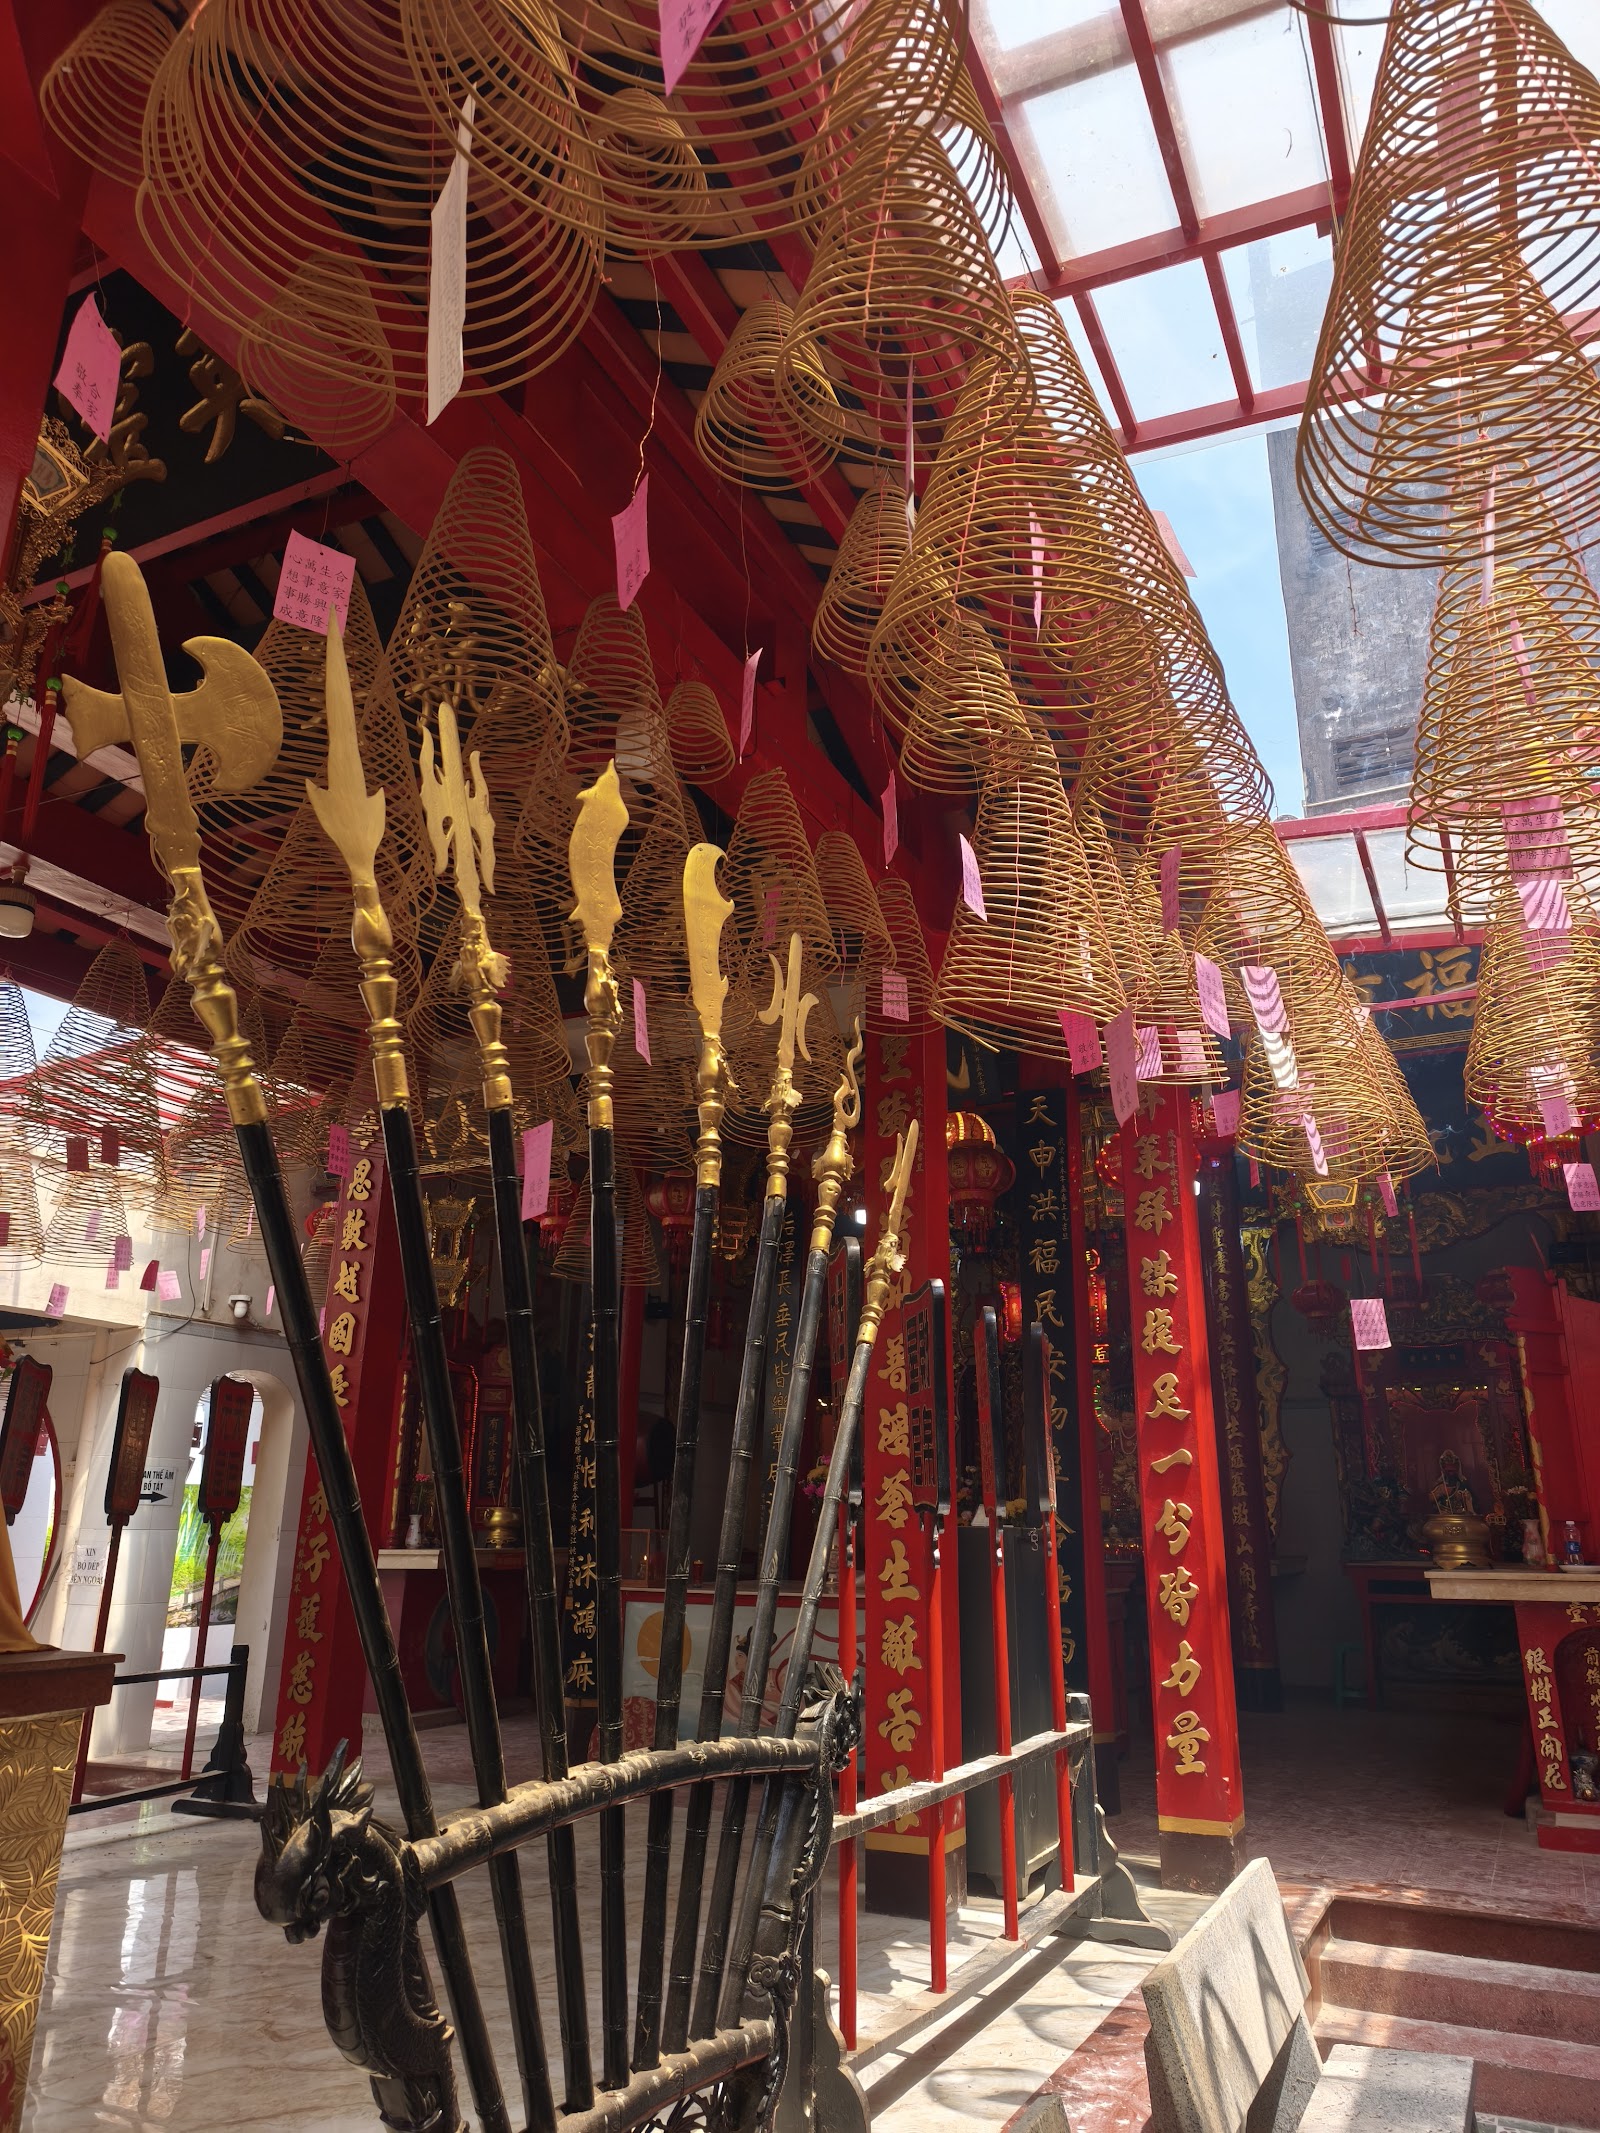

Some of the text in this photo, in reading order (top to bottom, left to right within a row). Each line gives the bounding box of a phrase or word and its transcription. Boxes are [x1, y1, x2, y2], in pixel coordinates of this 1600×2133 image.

[279, 554, 303, 621] 心想事成
[294, 557, 317, 624] 萬事勝意
[310, 565, 332, 630] 生意興隆
[1525, 1647, 1567, 1791] 銀樹正開花
